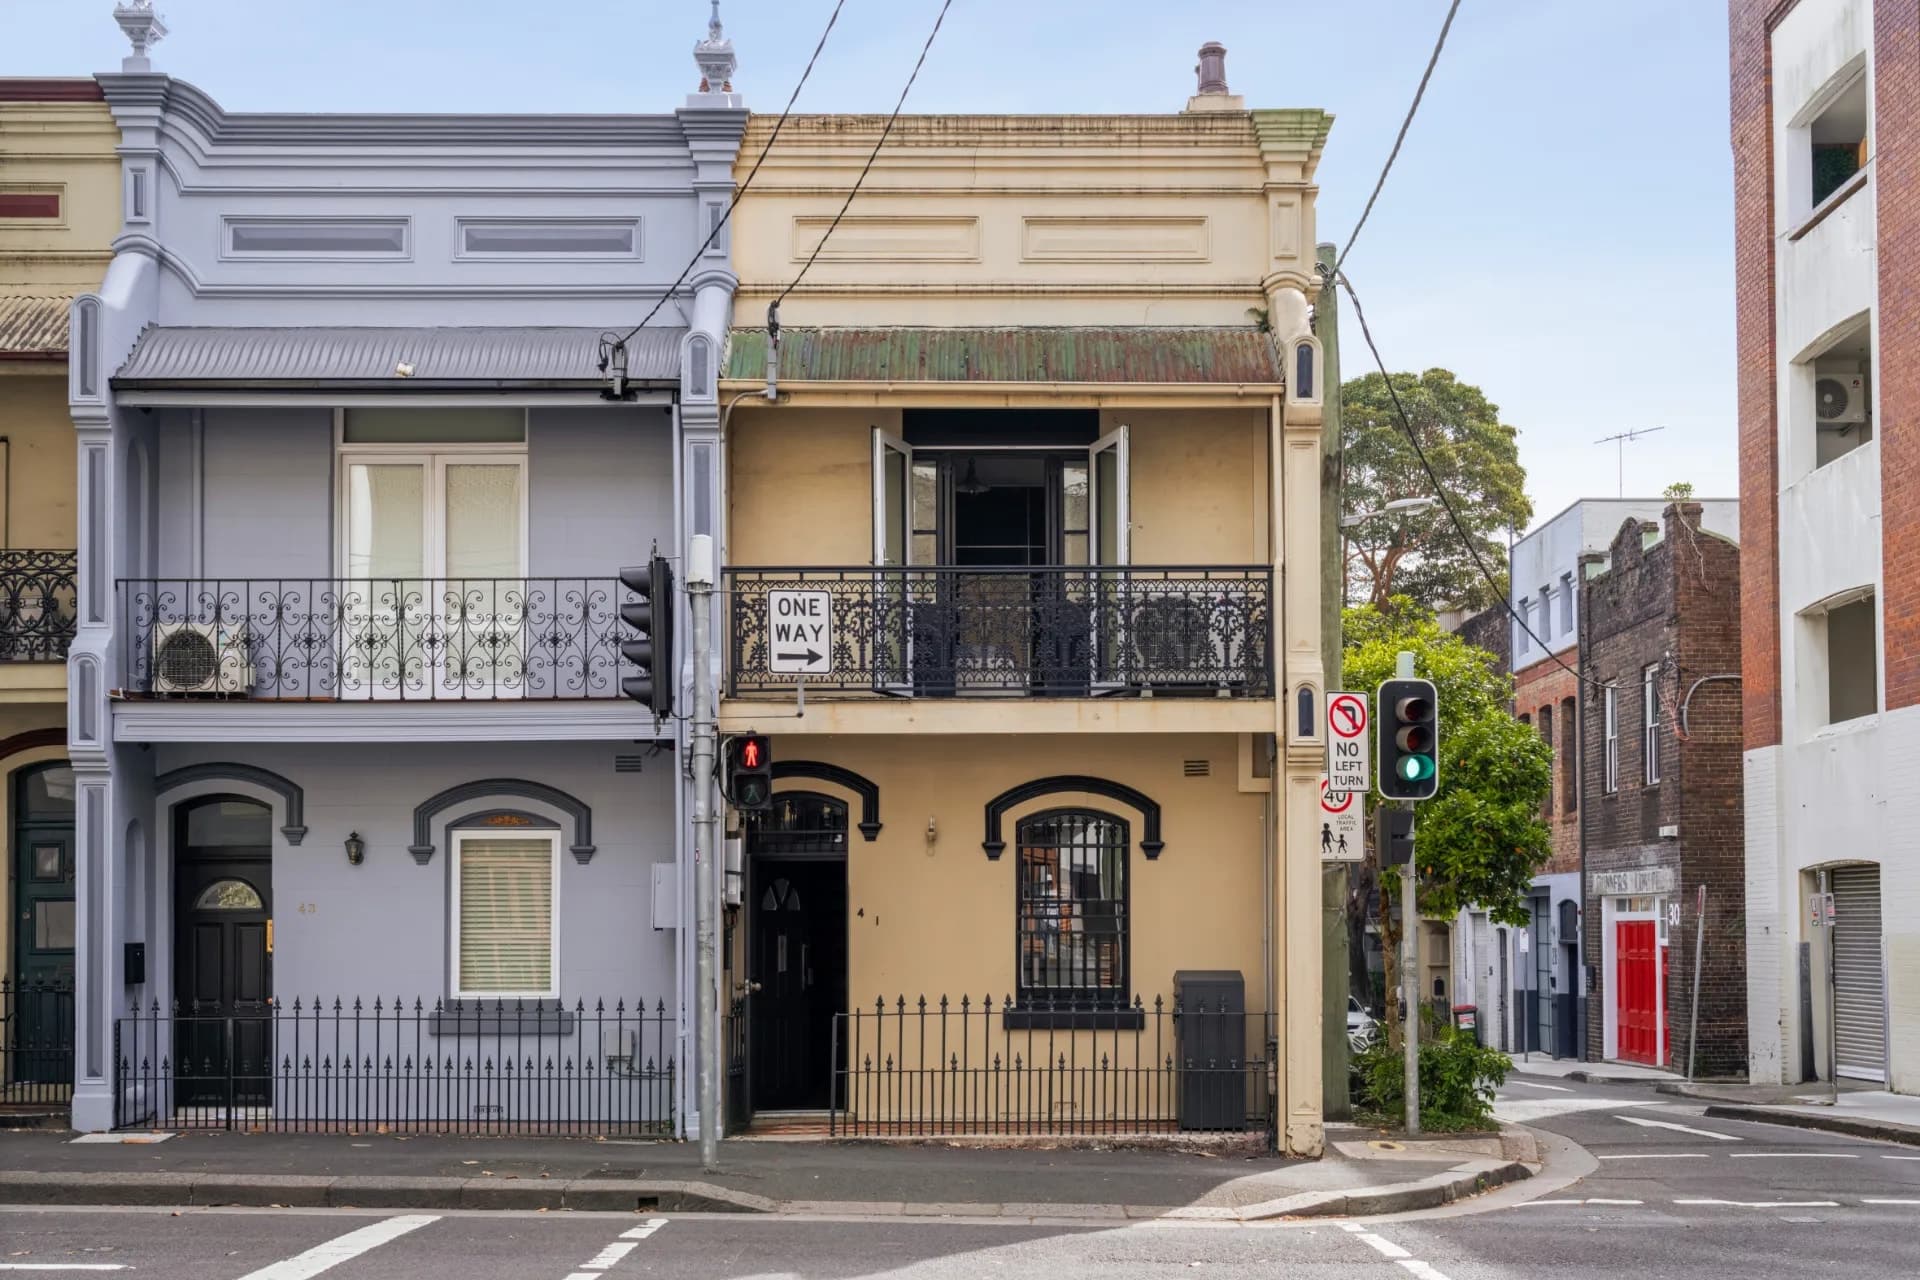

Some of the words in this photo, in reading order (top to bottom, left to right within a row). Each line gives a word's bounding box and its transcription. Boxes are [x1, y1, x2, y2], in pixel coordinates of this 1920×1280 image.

[778, 597, 821, 616] ONE
[775, 623, 824, 642] WAY
[1336, 742, 1359, 757] NO
[1335, 761, 1363, 771] LEFT
[1333, 775, 1364, 786] TURN
[1323, 791, 1346, 803] 40
[1669, 903, 1680, 926] 30
